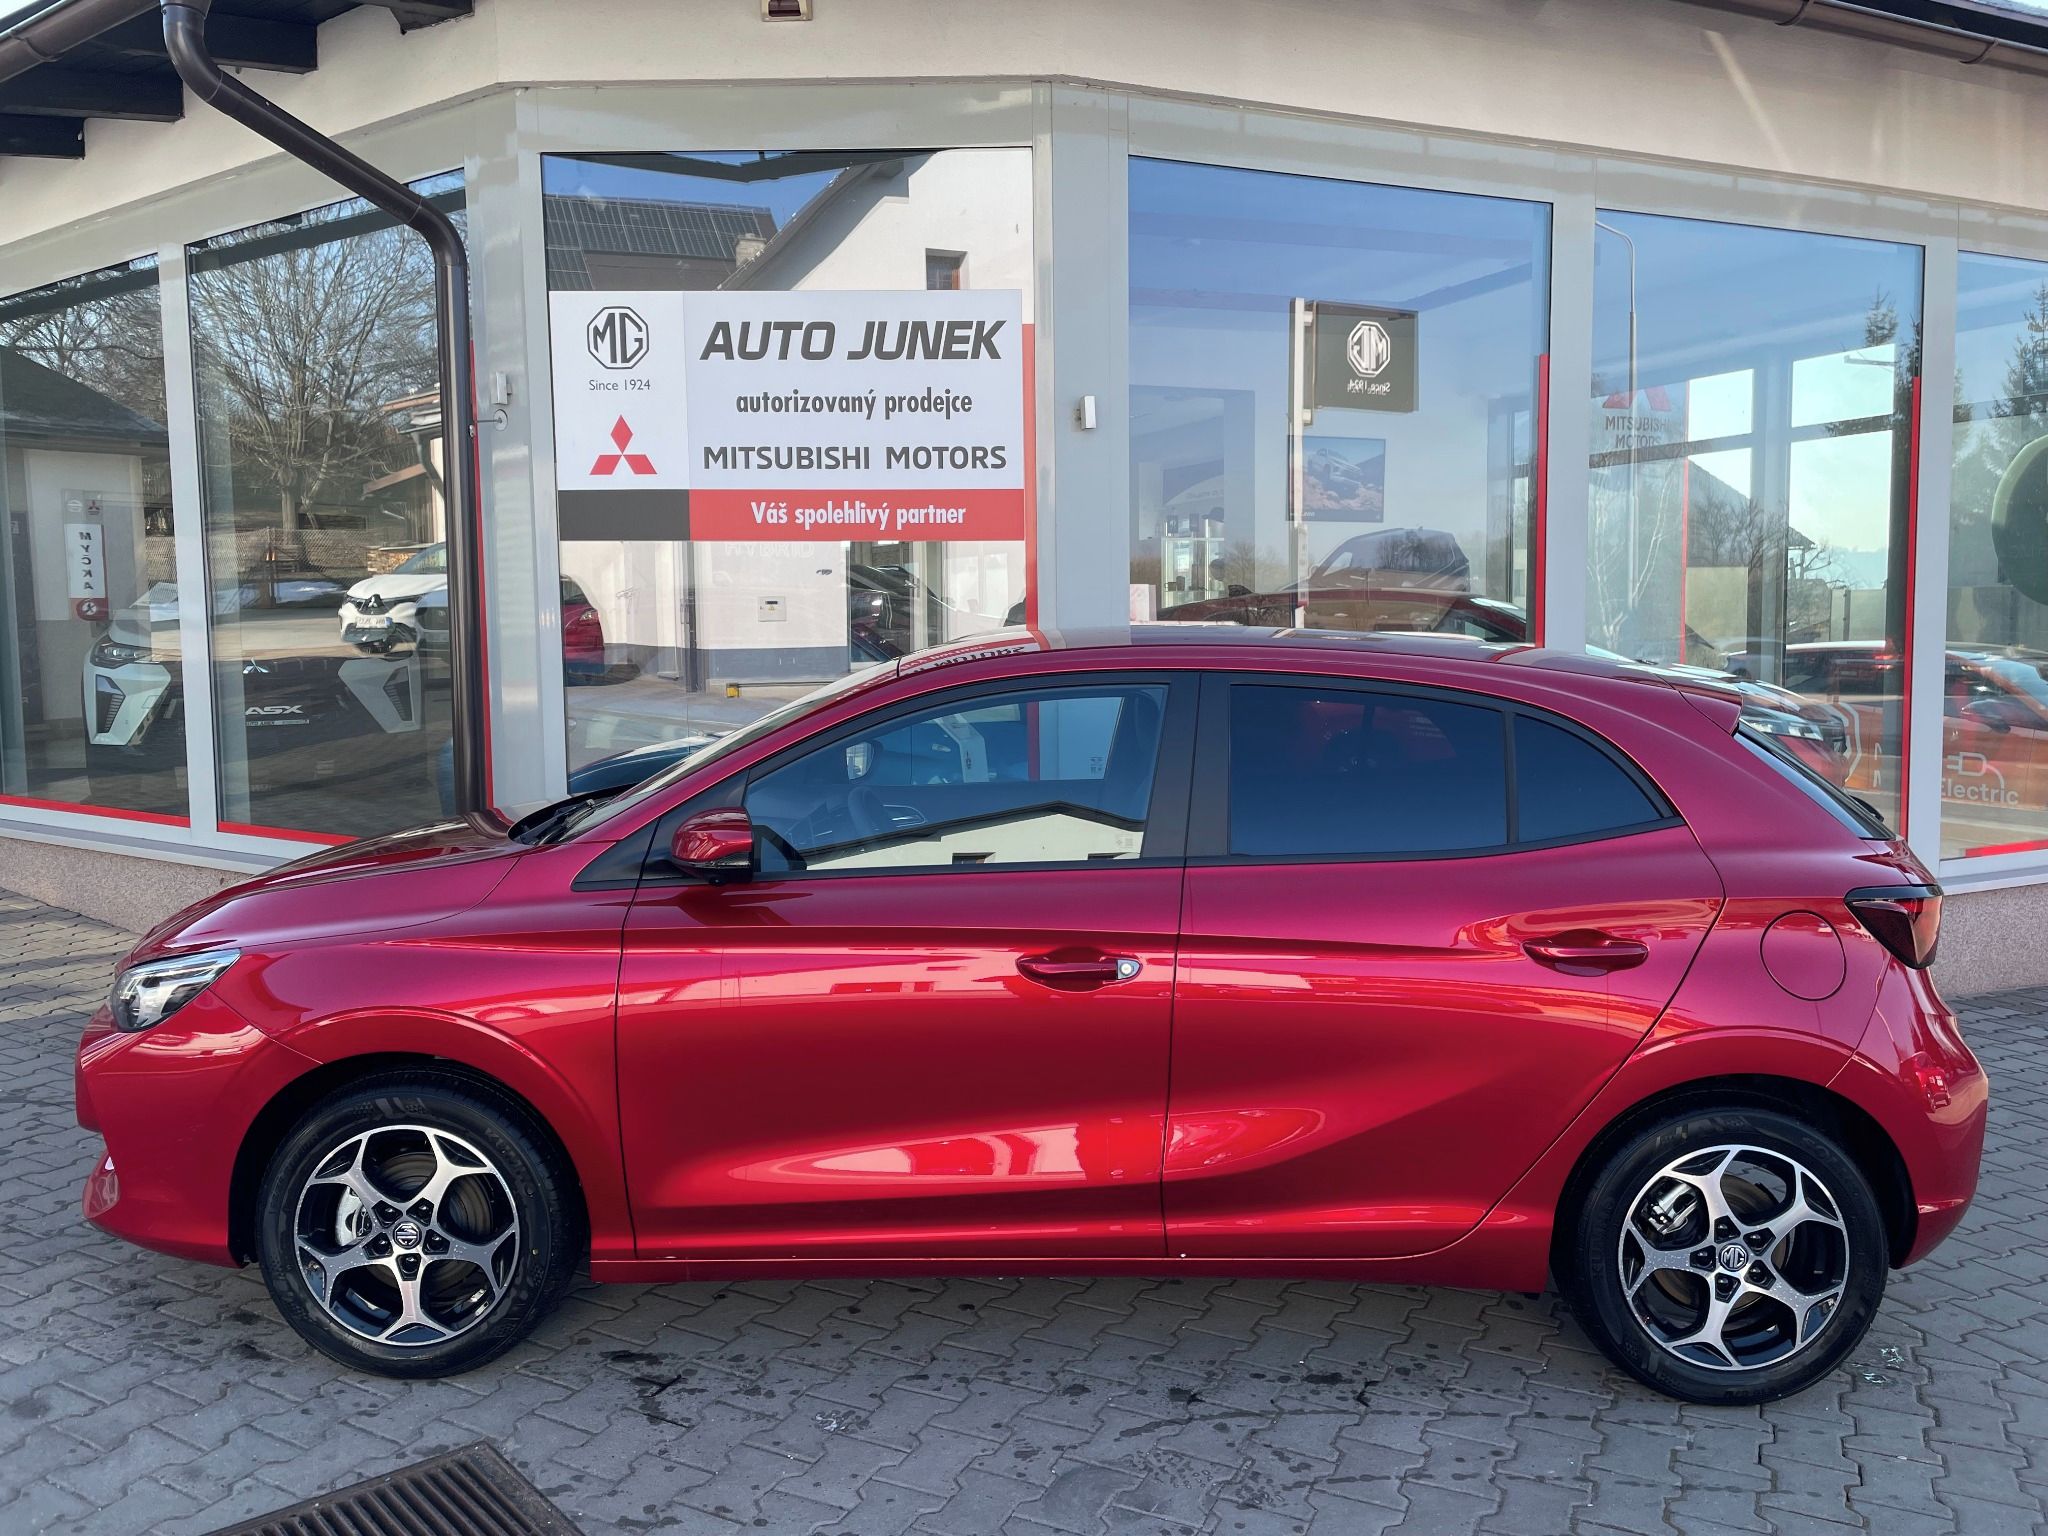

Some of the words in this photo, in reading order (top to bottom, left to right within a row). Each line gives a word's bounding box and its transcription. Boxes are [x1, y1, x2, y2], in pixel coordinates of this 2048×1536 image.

[590, 309, 646, 366] MG
[699, 321, 836, 361] AUTO
[846, 320, 1007, 360] JUNEK
[589, 379, 619, 391] Since
[624, 379, 651, 391] 1924
[736, 389, 875, 420] autorizovaný
[884, 387, 973, 420] prodejce
[703, 446, 870, 469] MITSUBISHI
[886, 446, 1007, 469] MOTORS
[751, 502, 788, 524] Váš
[795, 501, 890, 530] spolehlivý
[896, 505, 966, 530] partner
[245, 705, 304, 716] ASX
[1723, 1246, 1746, 1269] MG
